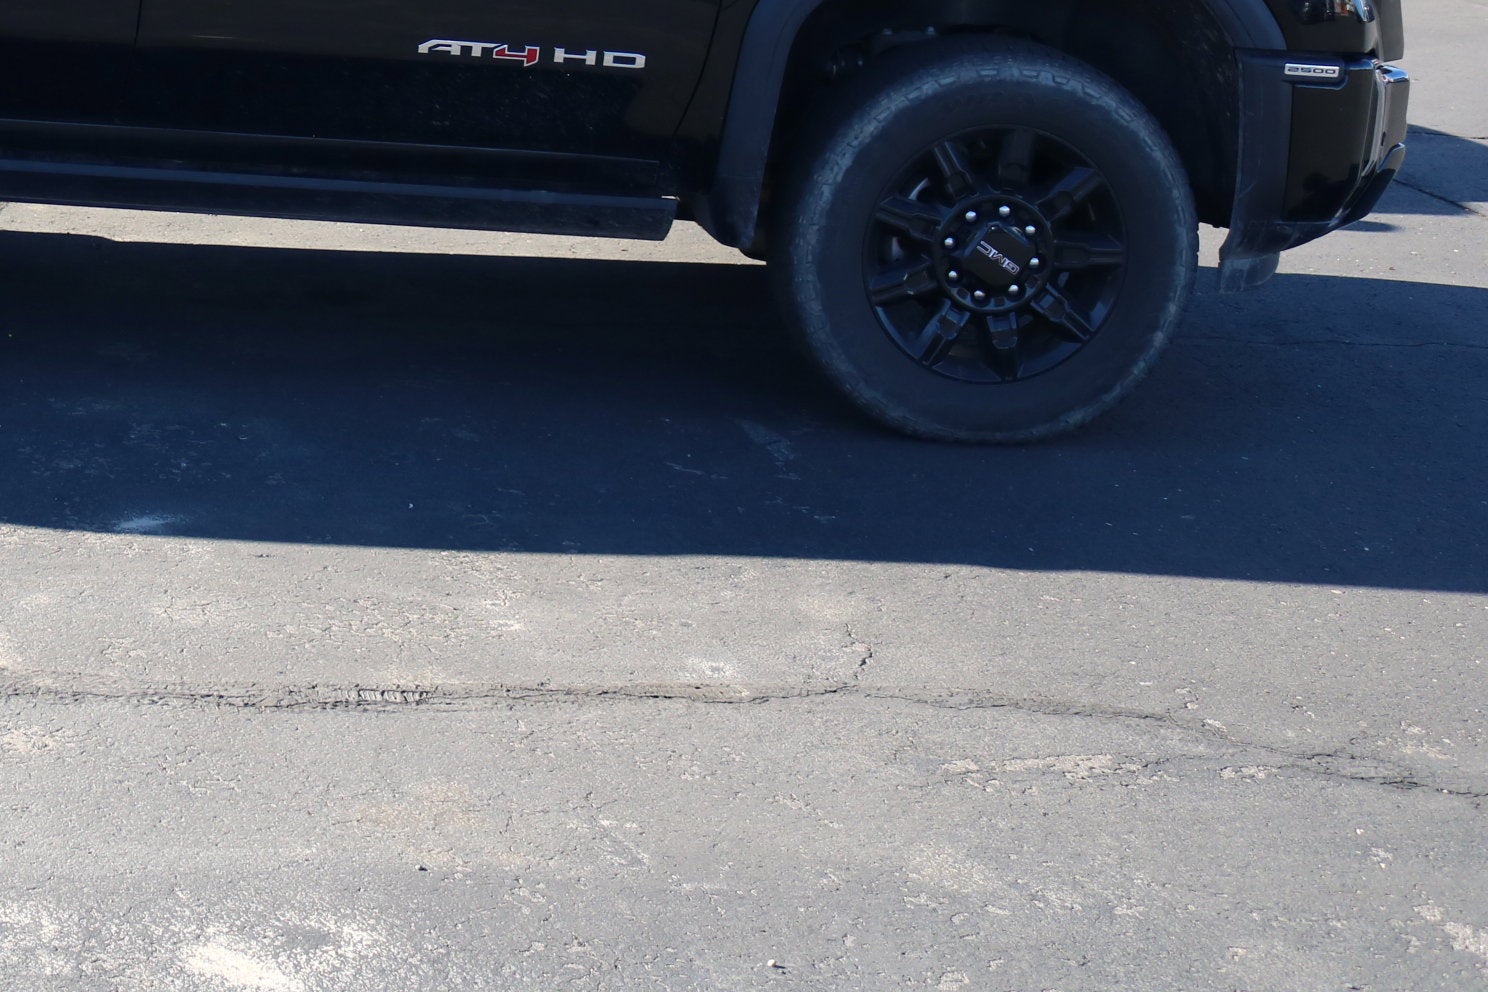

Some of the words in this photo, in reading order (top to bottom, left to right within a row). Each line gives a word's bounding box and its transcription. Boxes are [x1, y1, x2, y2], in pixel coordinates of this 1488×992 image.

[417, 39, 540, 67] AT4
[554, 47, 646, 69] HD
[1287, 66, 1336, 75] 2500
[976, 240, 1020, 275] GMC
